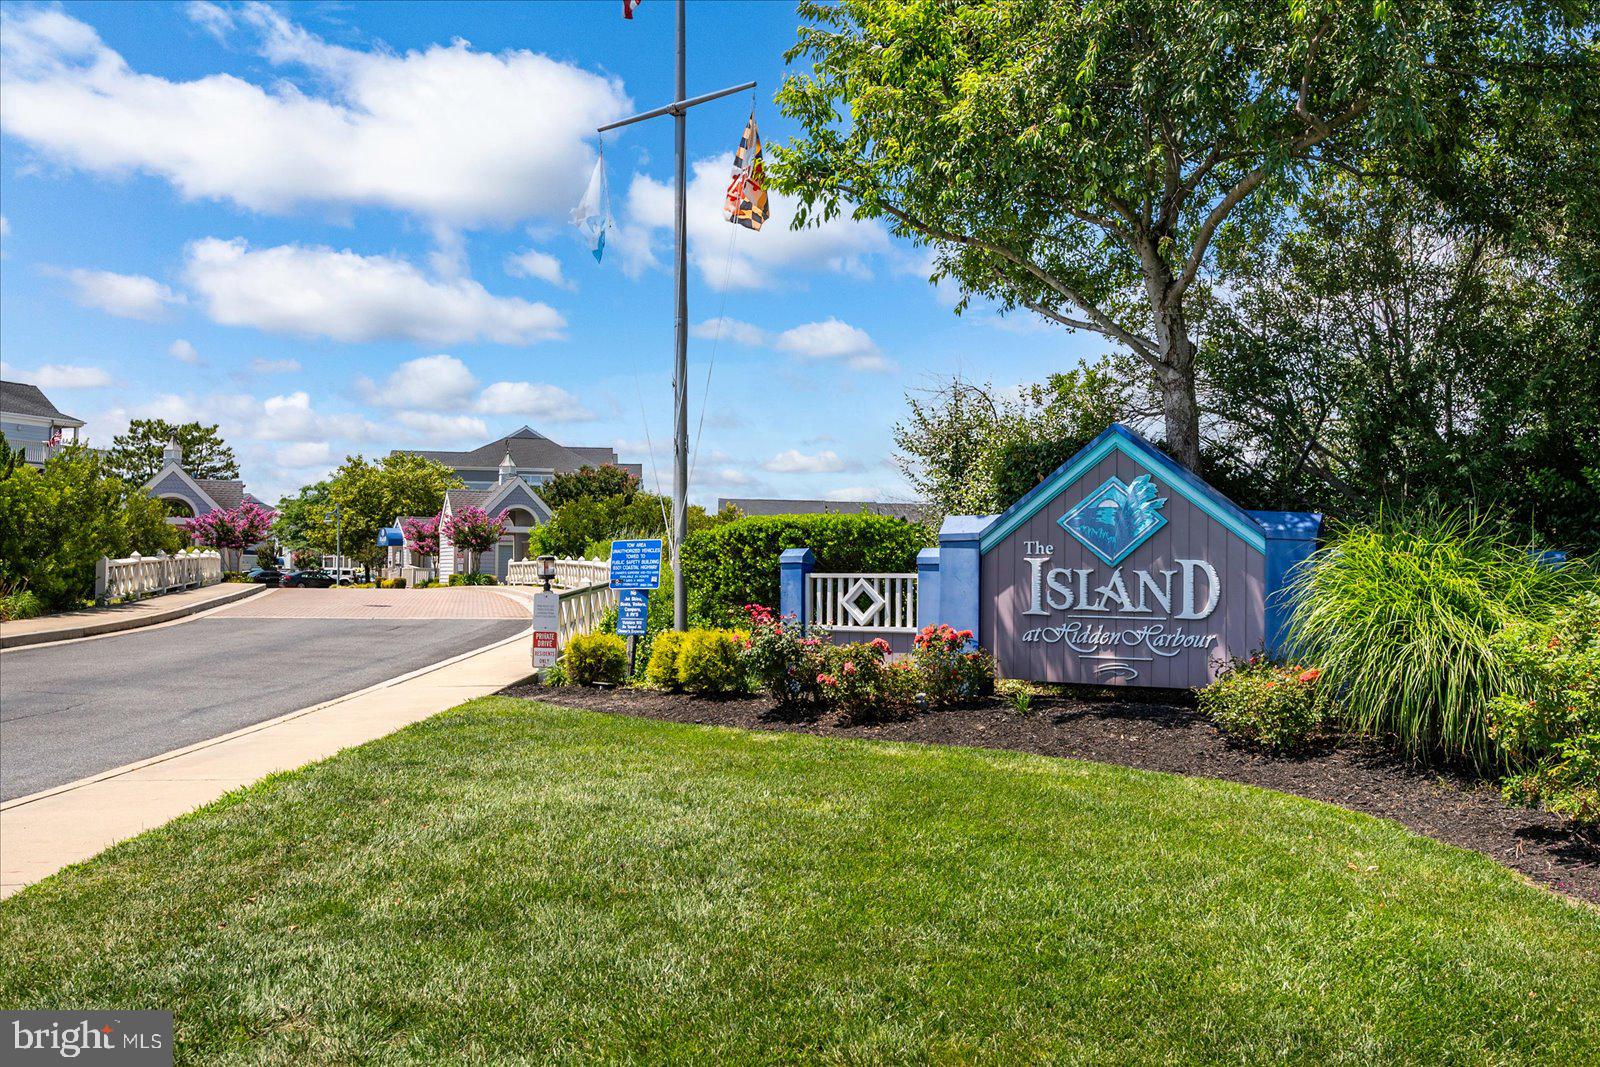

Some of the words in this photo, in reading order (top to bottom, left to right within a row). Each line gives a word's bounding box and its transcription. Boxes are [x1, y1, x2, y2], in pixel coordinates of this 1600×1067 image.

[1024, 541, 1054, 555] The
[1022, 557, 1221, 620] ISLAND
[1022, 627, 1040, 642] at
[1042, 622, 1120, 652] Hidden
[1121, 625, 1217, 657] Harbour
